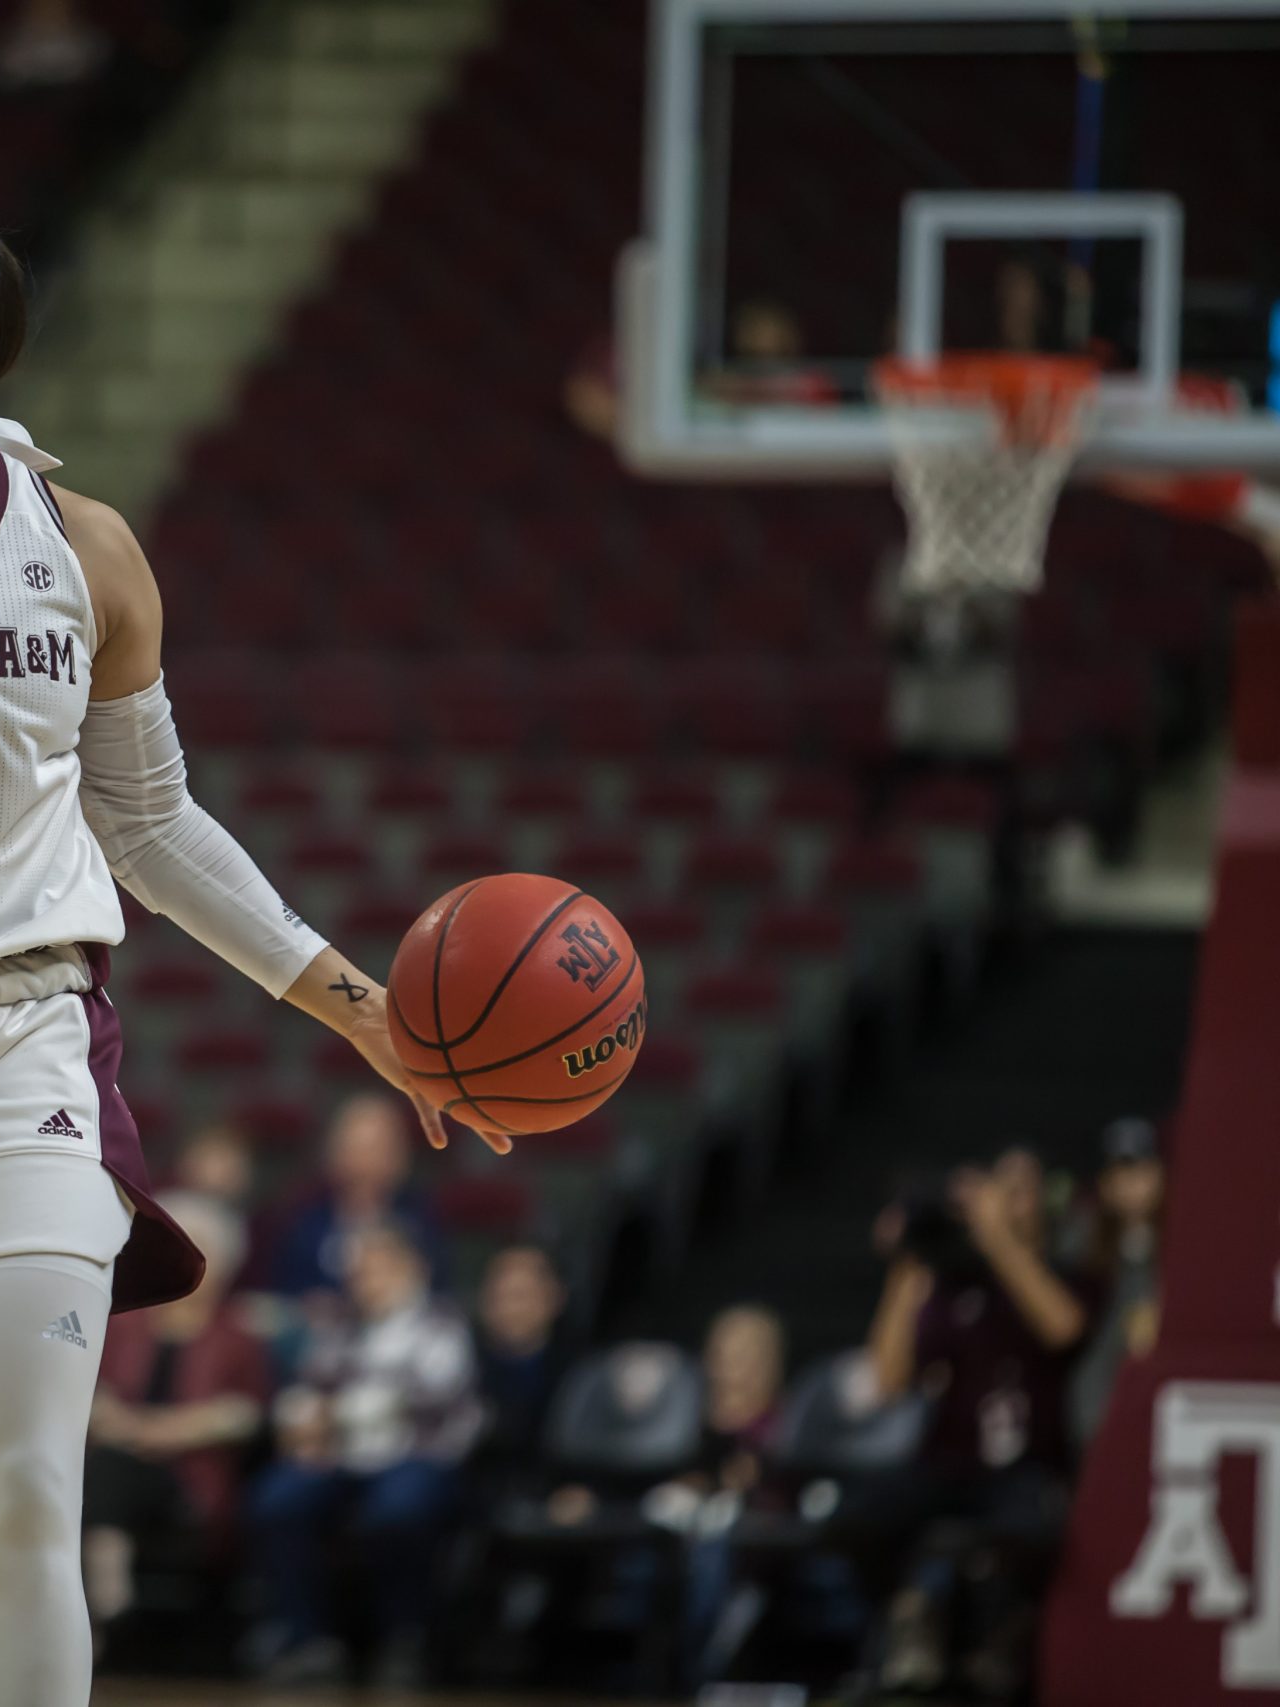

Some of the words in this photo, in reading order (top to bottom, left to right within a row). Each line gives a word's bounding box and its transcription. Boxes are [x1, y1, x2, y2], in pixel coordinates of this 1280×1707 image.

[22, 563, 52, 590] SEC
[562, 1001, 644, 1078] ilson
[38, 1126, 84, 1140] adidas
